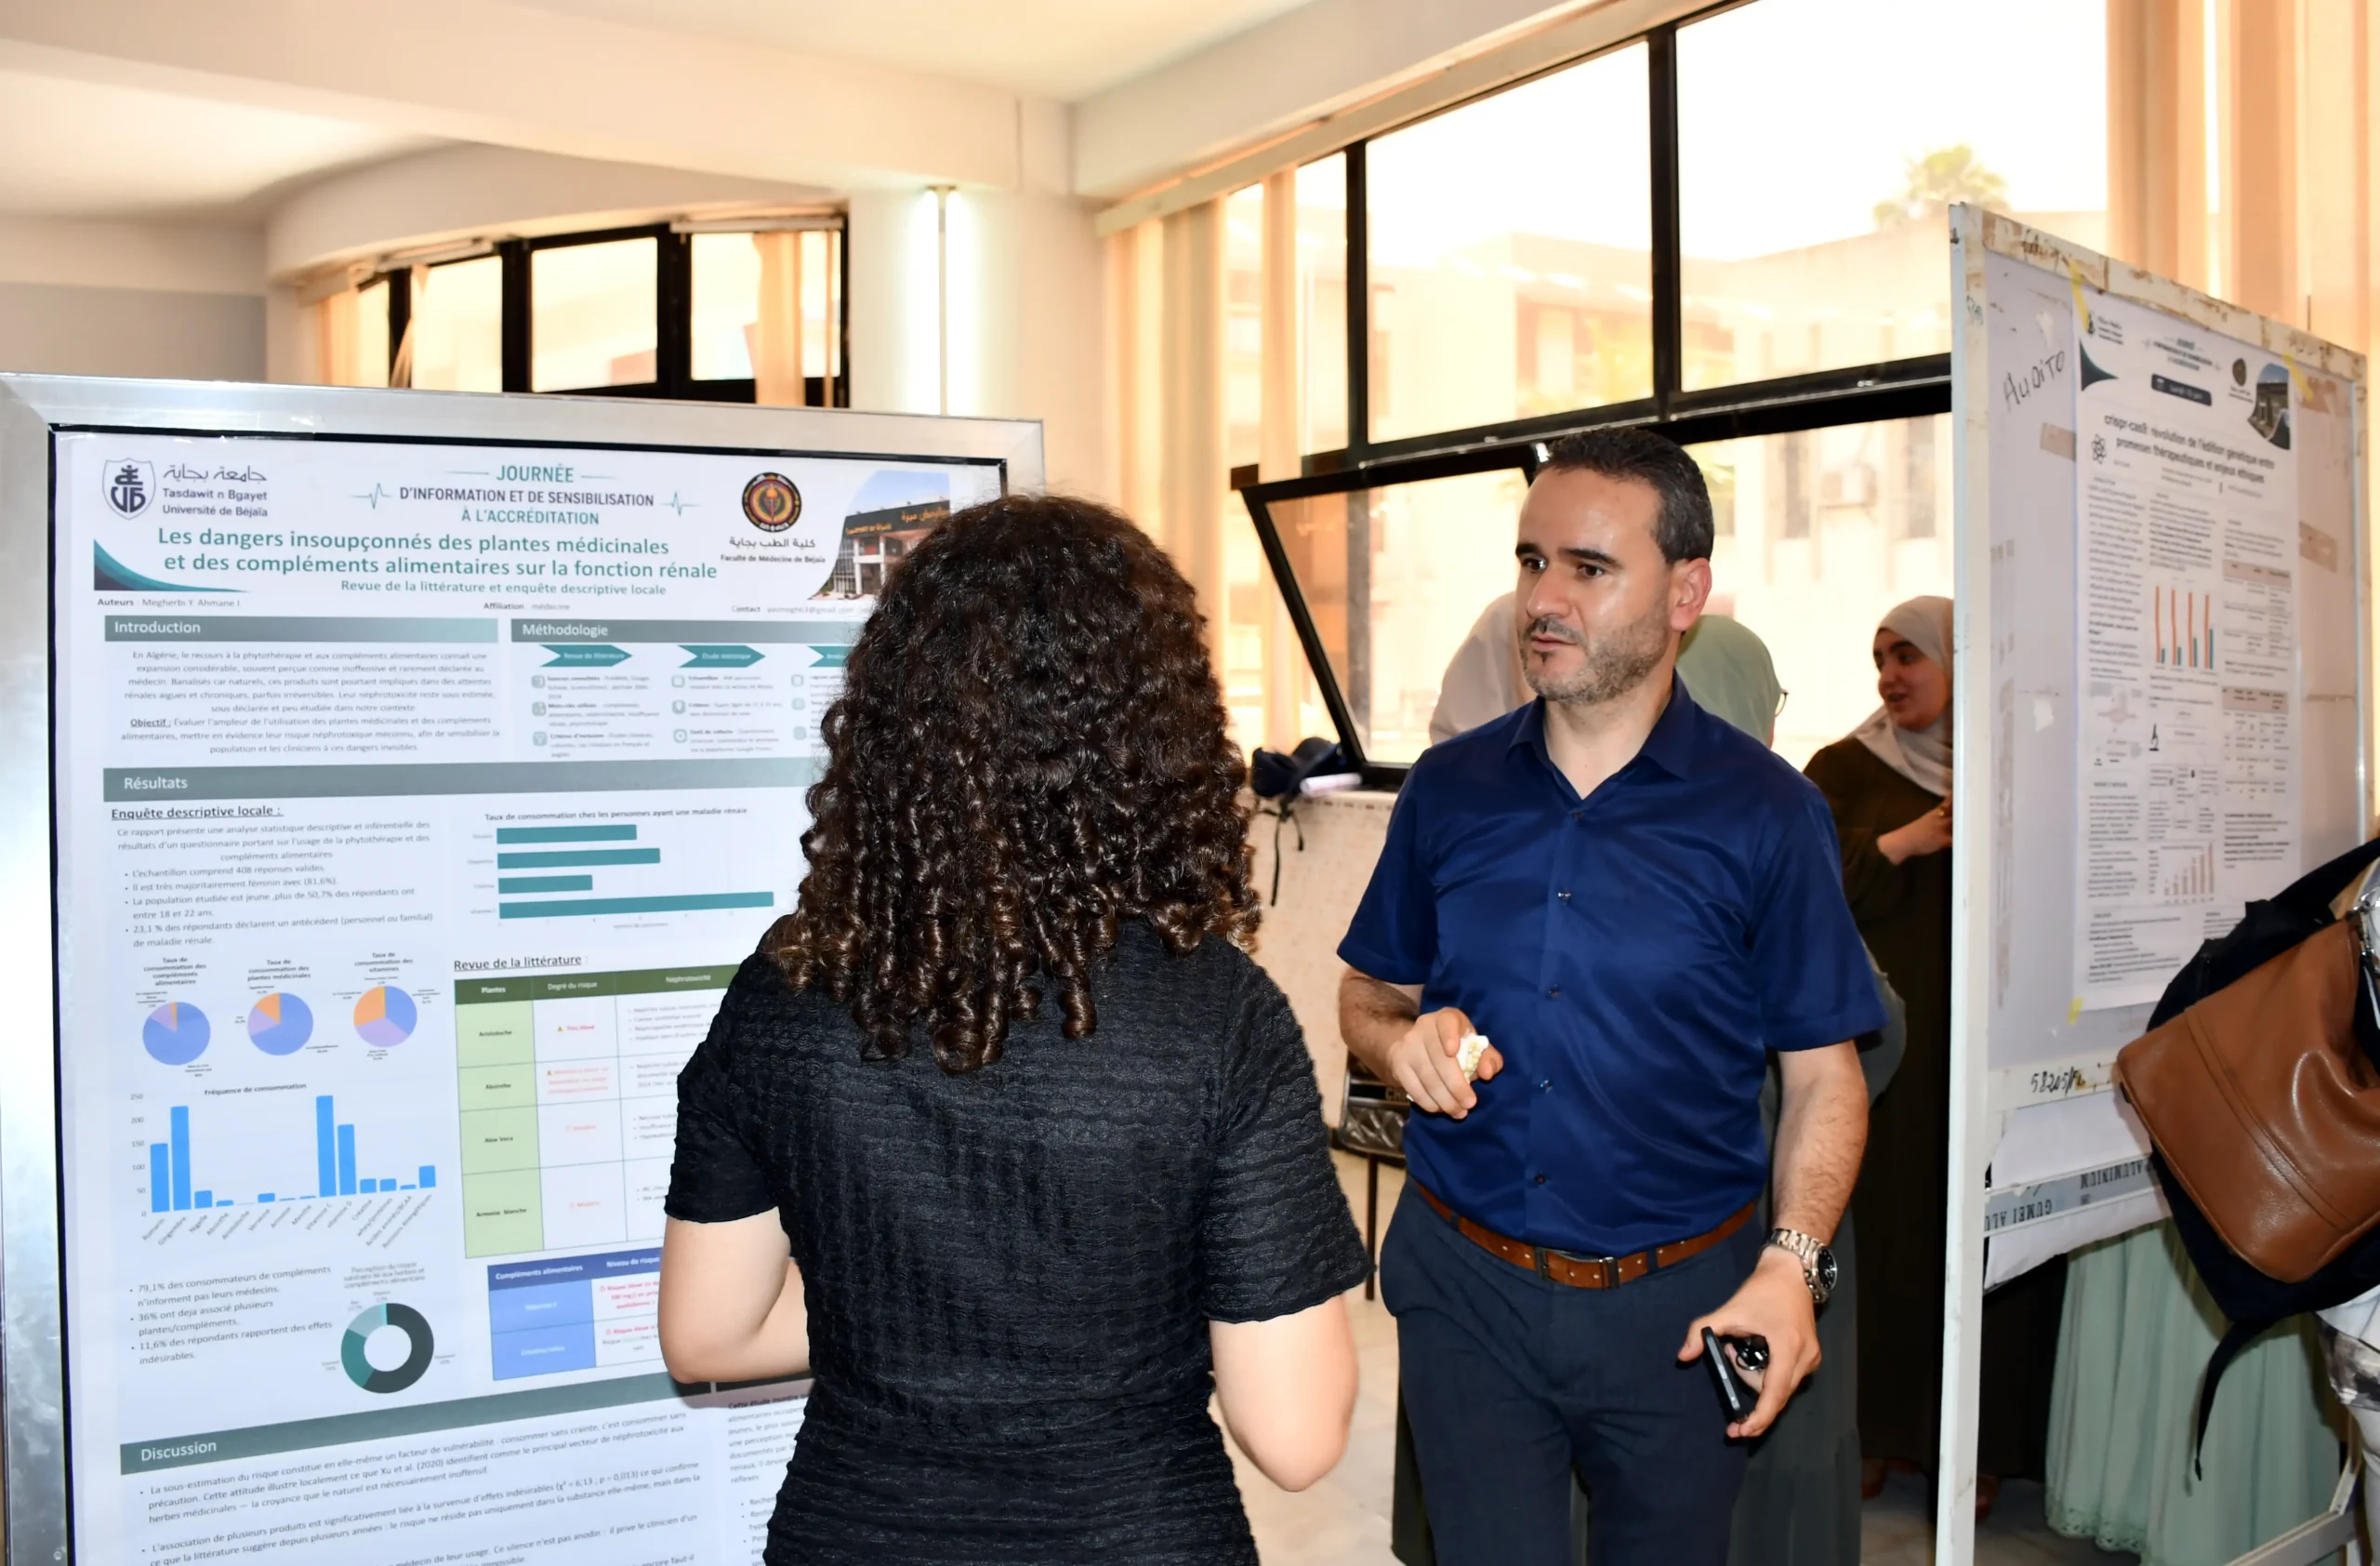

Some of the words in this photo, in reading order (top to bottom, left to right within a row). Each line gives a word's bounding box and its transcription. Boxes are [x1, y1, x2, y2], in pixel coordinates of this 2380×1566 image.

[214, 465, 267, 484] جامعة
[496, 465, 574, 482] JOURNÉE
[162, 487, 214, 498] Tasdawit
[227, 489, 267, 501] Bgayet
[400, 486, 506, 501] D'INFORMATION
[509, 490, 524, 502] ET
[527, 490, 544, 502] DE
[548, 491, 654, 505] SENSIBILISATION
[162, 505, 216, 514] Université
[218, 506, 232, 515] de
[461, 506, 470, 521] À
[475, 510, 599, 524] L'ACCRÉDITATION
[158, 527, 192, 544] Les
[199, 528, 283, 550] dangers
[290, 531, 431, 551] insoupçonnés
[438, 534, 472, 550] des
[479, 535, 549, 553] plantes
[556, 537, 668, 553] médicinales
[164, 554, 185, 569] et
[192, 553, 229, 570] des
[236, 555, 378, 574] compléments
[385, 558, 509, 574] alimentaires
[516, 564, 546, 575] sur
[552, 561, 567, 575] la
[574, 562, 653, 577] fonction
[659, 564, 717, 577] rénale
[340, 579, 381, 591] Revue
[385, 580, 401, 591] de
[404, 580, 416, 591] la
[420, 581, 485, 591] littérature
[489, 583, 501, 592] et
[505, 583, 557, 593] enquête
[560, 584, 627, 595] descriptive
[630, 584, 666, 594] locale
[97, 598, 134, 607] Auteurs
[114, 620, 201, 632] Introduction
[522, 623, 608, 637] Méthodologie
[124, 776, 188, 789] Résultats
[112, 808, 164, 819] Enquête
[167, 806, 234, 818] descriptive
[237, 805, 273, 816] locale
[454, 960, 489, 971] Revue
[494, 958, 507, 969] de
[510, 957, 521, 968] la
[524, 955, 581, 967] littérature
[140, 1441, 217, 1461] Discussion
[150, 1486, 161, 1494] La
[237, 1473, 249, 1481] du
[251, 1470, 279, 1479] risque
[281, 1464, 322, 1475] constitue
[398, 1449, 428, 1457] facteur
[500, 1432, 549, 1443] consommer
[149, 1513, 180, 1523] herbes
[260, 1495, 301, 1506] croyance
[303, 1493, 320, 1501] que
[332, 1484, 364, 1495] naturel
